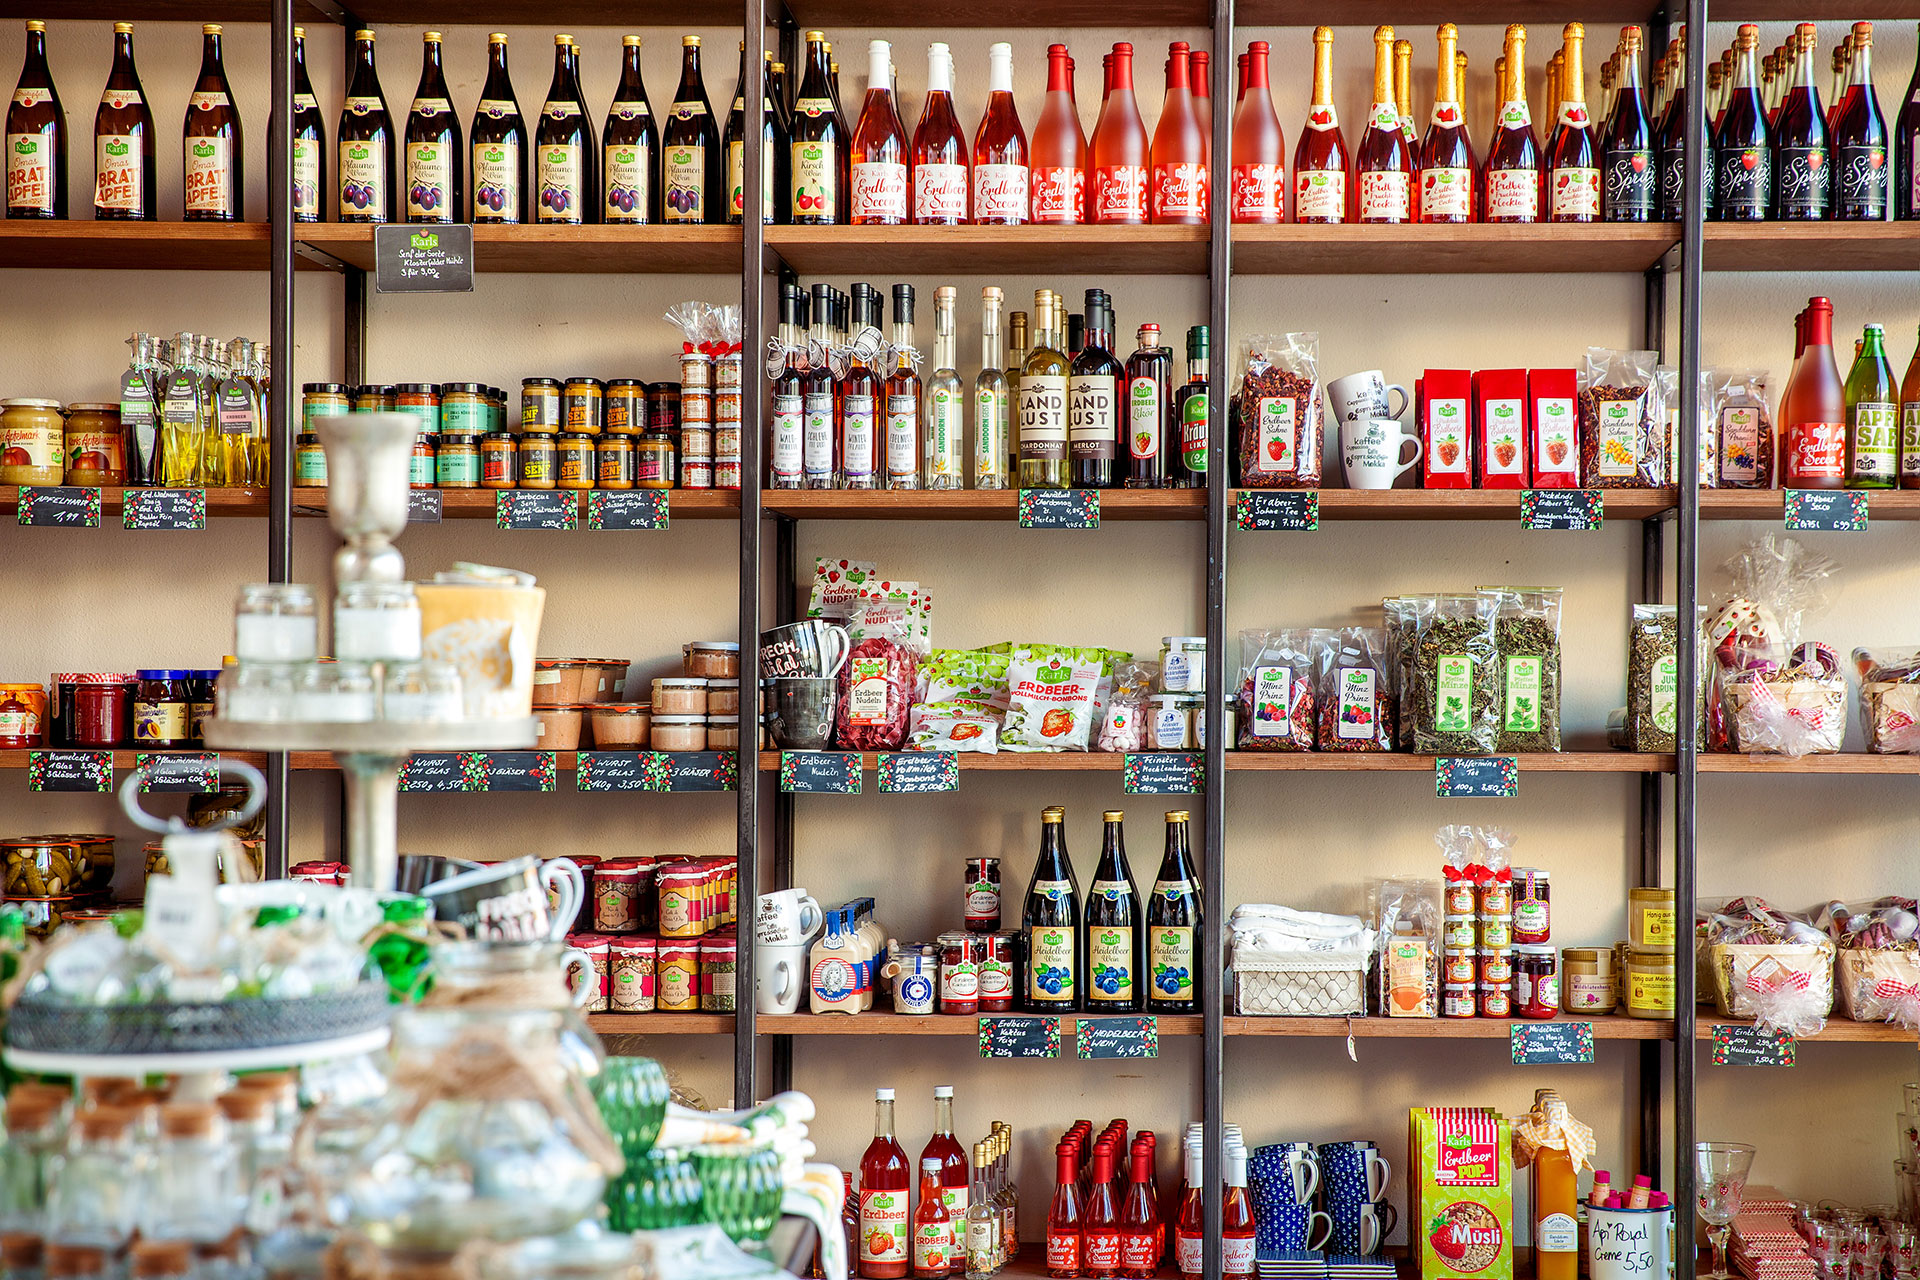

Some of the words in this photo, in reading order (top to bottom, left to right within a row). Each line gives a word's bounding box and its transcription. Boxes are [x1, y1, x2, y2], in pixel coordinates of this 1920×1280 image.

[16, 144, 36, 152] Karls
[106, 146, 128, 154] Karls
[193, 148, 215, 156] Karls
[417, 152, 436, 160] Karls
[484, 152, 503, 160] Karls
[803, 150, 822, 158] Karls
[14, 157, 37, 166] Omas
[104, 159, 129, 168] Omas
[192, 160, 216, 170] Omas
[800, 160, 824, 170] Kirsch
[8, 166, 45, 187] BRAT
[99, 168, 139, 189] BRAT
[187, 169, 225, 189] BRAT
[1608, 160, 1656, 200] Spritz
[1720, 157, 1769, 199] Spritz
[1782, 157, 1830, 198] Spritz
[857, 178, 902, 195] Erdbeer
[923, 180, 966, 196] Erdbeer
[980, 180, 1024, 196] Erdbeer
[8, 184, 48, 202] APFEL
[97, 184, 139, 202] APFEL
[187, 187, 225, 205] APFEL
[861, 194, 896, 208] Secco
[929, 195, 962, 208] Secco
[989, 196, 1018, 209] Secco
[412, 236, 438, 247] Karls
[1134, 388, 1152, 396] Karls
[1132, 399, 1156, 407] ERDBEER
[1268, 405, 1287, 413] Karls
[1438, 408, 1457, 416] Karls
[1495, 408, 1513, 416] Karls
[1547, 408, 1565, 416] Karls
[1132, 408, 1154, 421] Likör
[1262, 415, 1291, 426] Erdbeer
[1602, 419, 1634, 428] Sanddorn
[1266, 425, 1288, 434] Sahne
[1607, 428, 1628, 436] Sahne
[1725, 424, 1757, 434] Sanddorn
[938, 418, 946, 453] SANDDORN
[982, 418, 990, 453] SANDDORN
[1074, 441, 1100, 449] MERLOT
[1354, 436, 1381, 446] kaffee
[1798, 437, 1843, 454] Erdbeer
[1363, 460, 1386, 468] Mokka
[1803, 452, 1836, 466] Secco
[525, 464, 551, 475] SENF
[515, 492, 550, 500] Barbecue
[1805, 493, 1837, 503] Erdbeer
[1810, 502, 1831, 511] Secco
[53, 511, 80, 523] 1,99
[861, 664, 878, 672] Karls
[1445, 666, 1464, 674] Karls
[1039, 669, 1069, 680] Karls
[1018, 681, 1084, 695] ERDBEER-
[1260, 681, 1283, 690] Minz
[1345, 683, 1369, 692] Minz
[1441, 681, 1468, 689] Minze
[1510, 681, 1538, 690] Minze
[854, 689, 883, 697] Erdbeer
[1011, 691, 1088, 702] VOLLMILCH-BONBONS
[1259, 690, 1284, 700] Prinz
[1345, 692, 1369, 702] Prinz
[49, 753, 90, 762] Marmelade
[414, 758, 448, 767] WURST
[800, 756, 837, 765] Erdbeer-
[596, 759, 632, 767] WURST
[607, 768, 636, 777] GLAS
[679, 767, 712, 778] GLÄSER
[811, 768, 839, 777] Nudeln
[895, 765, 937, 774] Vollmilch
[1466, 769, 1480, 777] Tee
[895, 774, 936, 782] Bonbons
[409, 780, 433, 791] 250g
[437, 779, 462, 790] 4,50
[618, 779, 642, 790] 3,50
[918, 781, 948, 791] 5,00€
[1034, 945, 1072, 955] Heidelbeer
[1092, 945, 1130, 955] Heidelbeer
[1153, 945, 1190, 955] Heidelbeer
[1398, 949, 1417, 957] Karls
[998, 1020, 1030, 1028] Erdbeer
[1091, 1039, 1118, 1047] WEIN
[1448, 1136, 1471, 1146] Karls
[1444, 1148, 1492, 1166] Erdbeer
[1458, 1164, 1486, 1179] POP
[874, 1198, 893, 1206] Karls
[863, 1209, 906, 1220] Erdbeer
[1452, 1222, 1500, 1245] Müsli
[1592, 1219, 1610, 1246] Api
[1614, 1222, 1649, 1250] Royal
[916, 1236, 950, 1245] ERDBEER
[1089, 1244, 1116, 1253] Erdbeer
[1123, 1244, 1149, 1253] Erdbeer
[1092, 1253, 1112, 1261] Secco
[1126, 1253, 1144, 1261] Secco
[1594, 1247, 1622, 1261] Creme
[1622, 1250, 1655, 1273] 5,50
